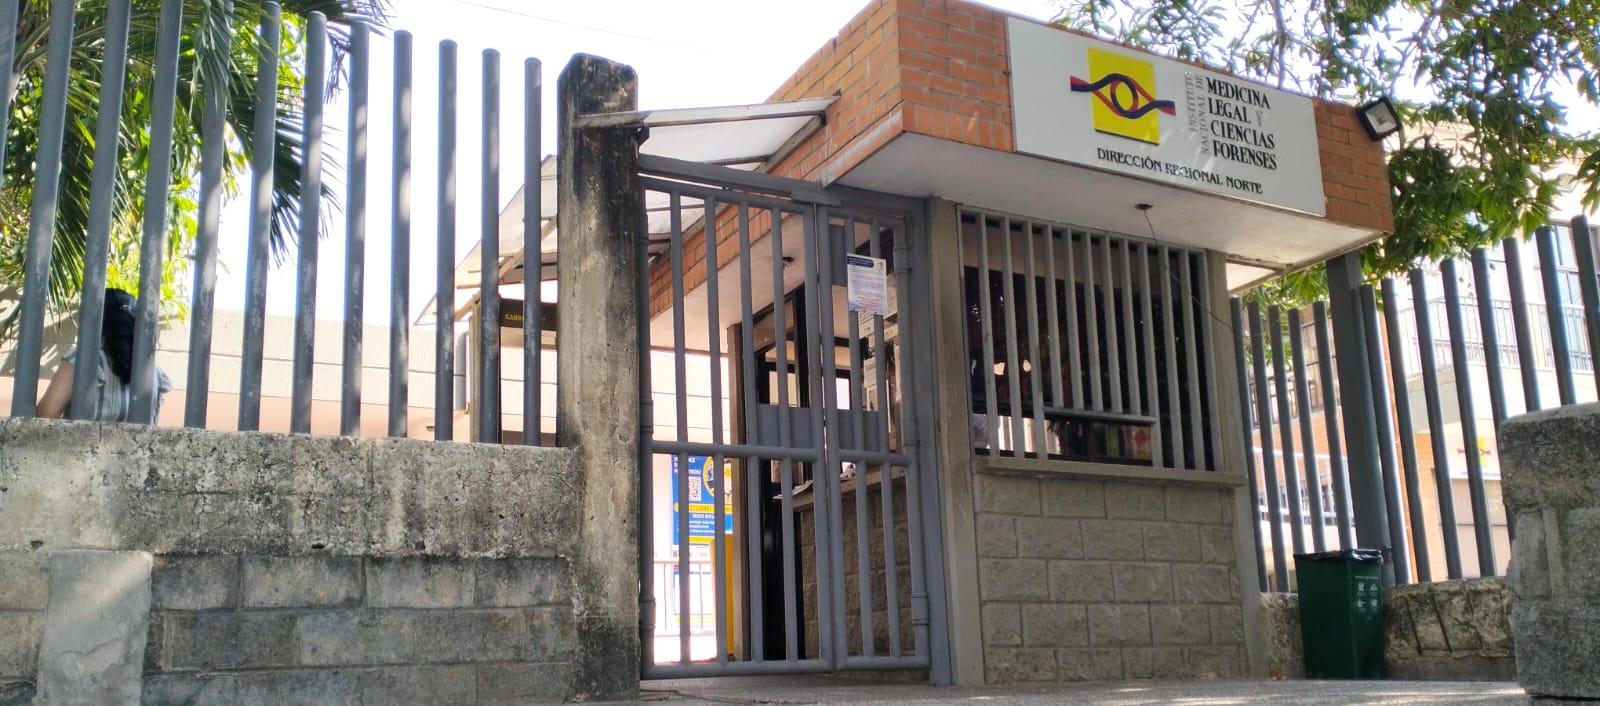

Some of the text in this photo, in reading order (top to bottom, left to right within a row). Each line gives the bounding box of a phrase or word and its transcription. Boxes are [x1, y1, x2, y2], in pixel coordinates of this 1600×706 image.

[1185, 71, 1198, 132] INSTITUTO
[1206, 76, 1271, 110] MEDICINA
[1195, 73, 1209, 154] NACIONAL DE
[1208, 97, 1264, 127] LEGAL Y
[1211, 119, 1275, 150] CIENCIAS
[1097, 147, 1263, 194] DIRECCIÓN REGIONAL NORTE
[1212, 139, 1277, 170] FORENSES
